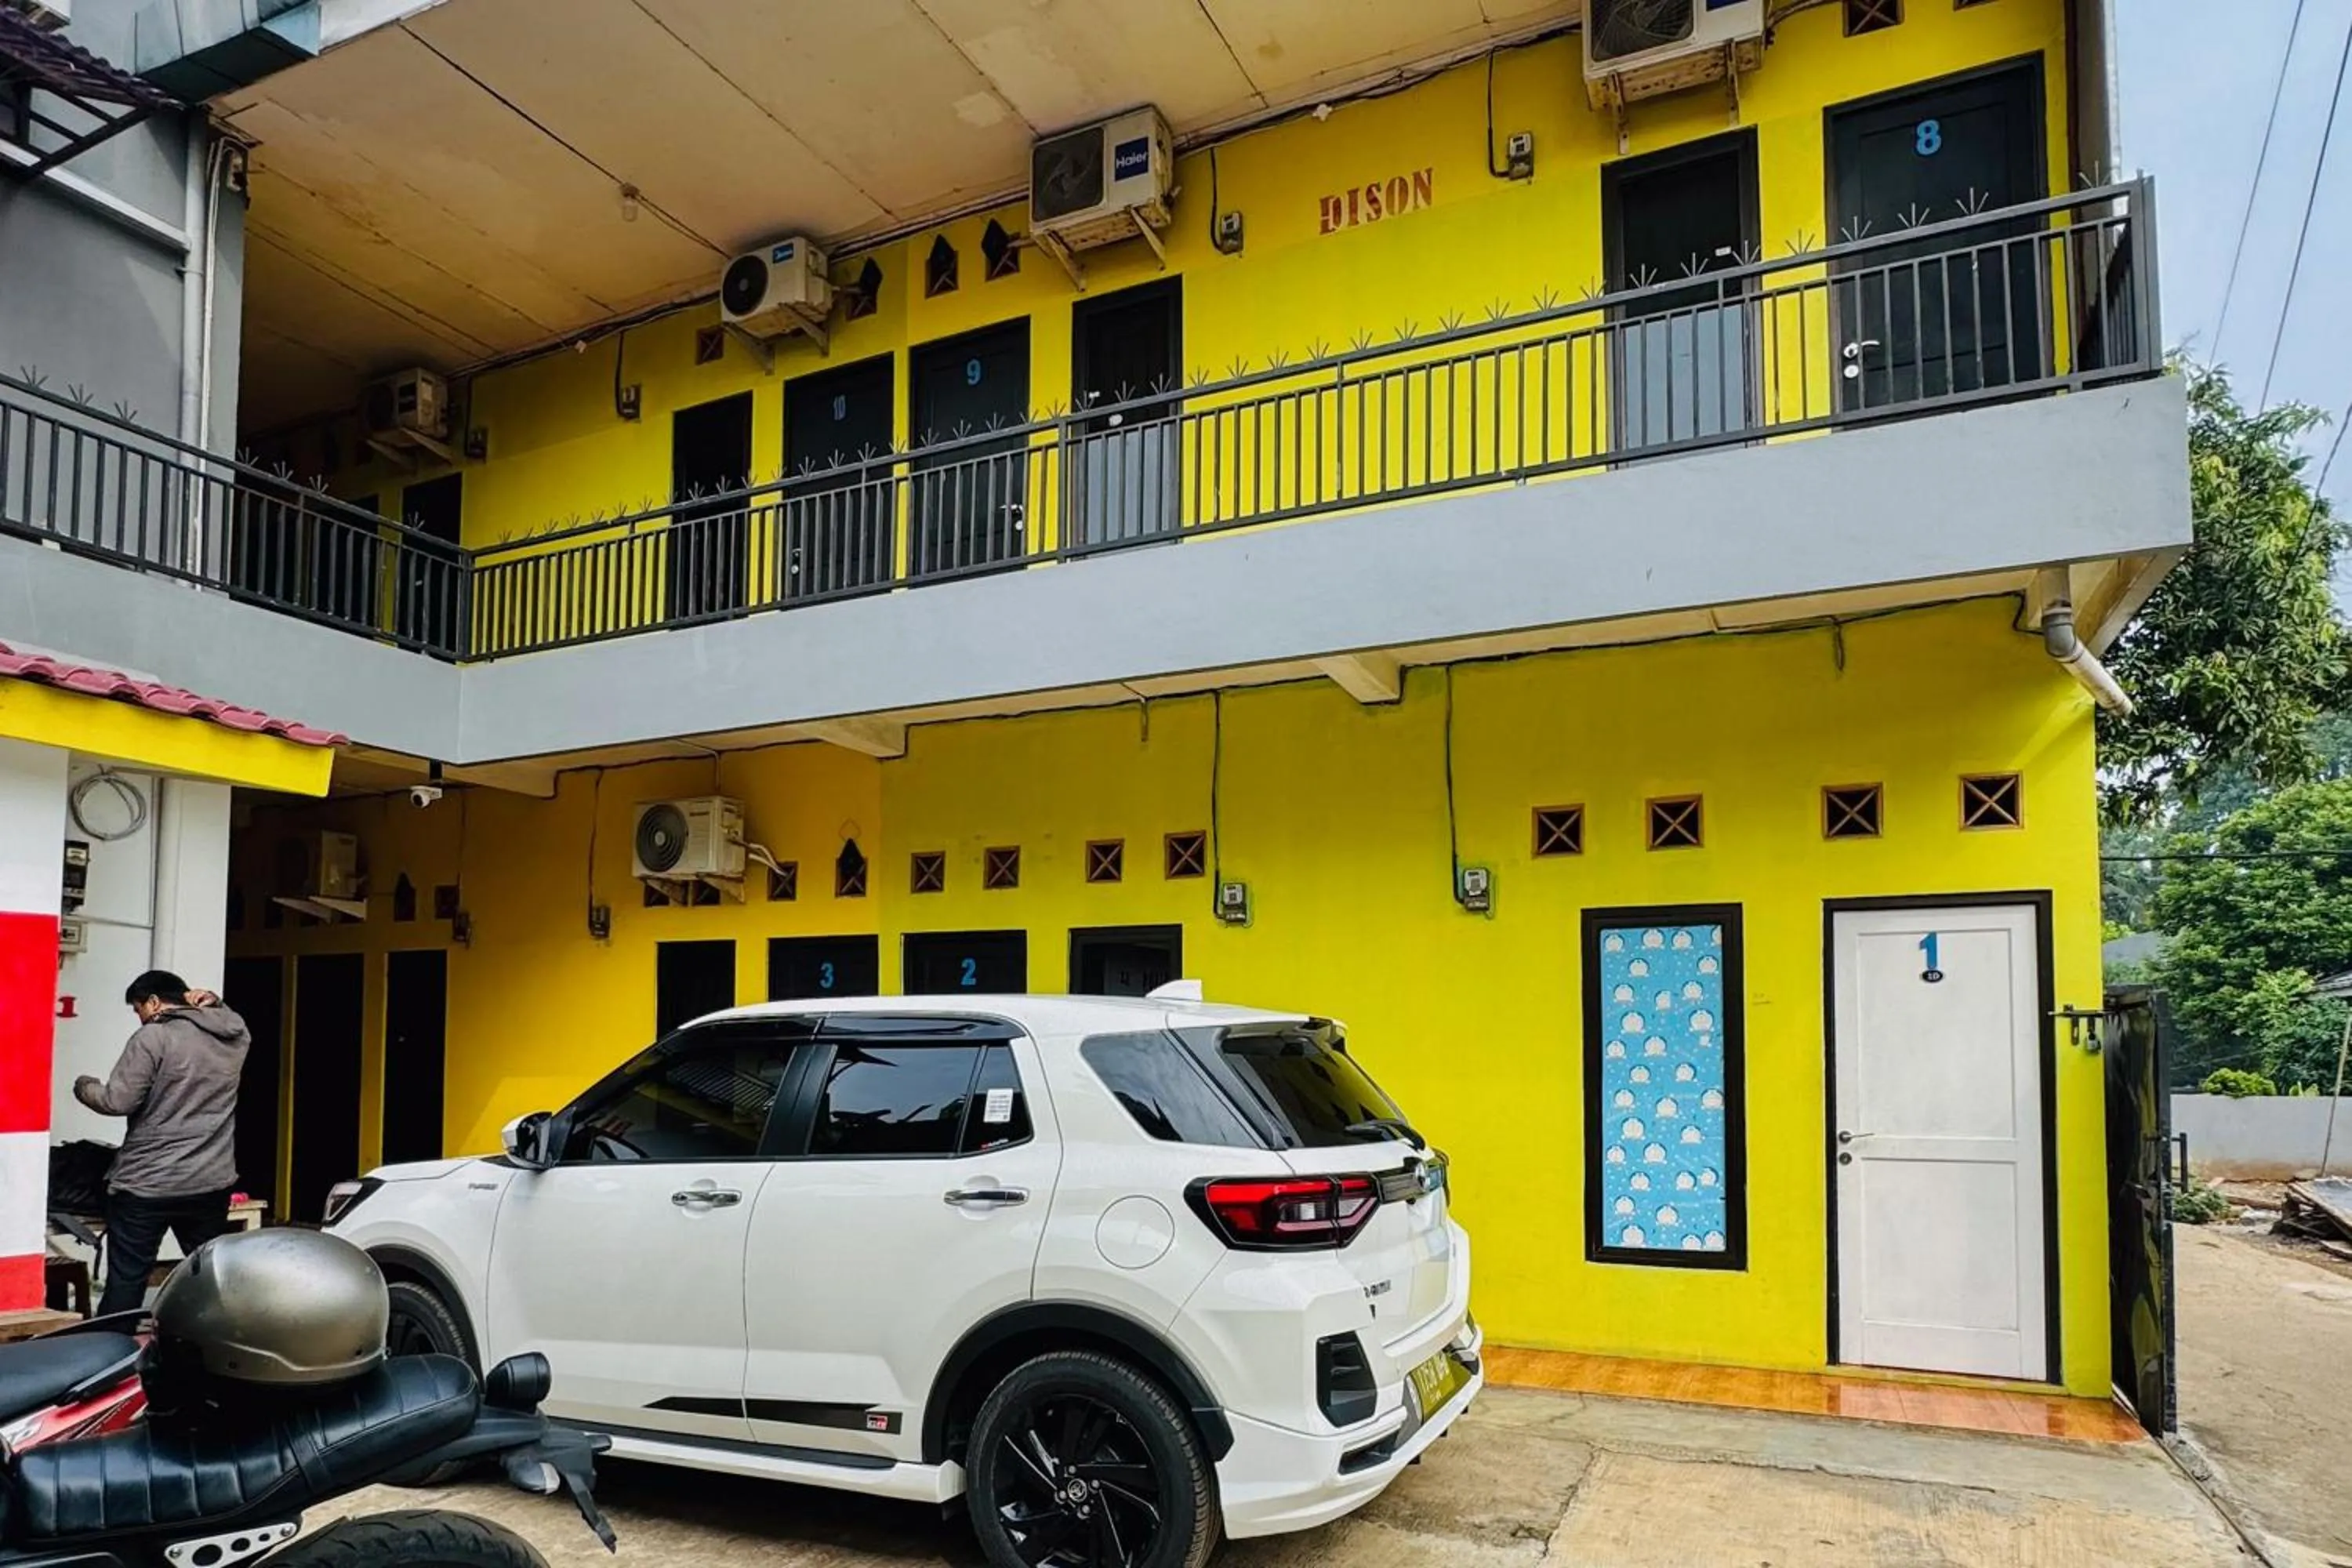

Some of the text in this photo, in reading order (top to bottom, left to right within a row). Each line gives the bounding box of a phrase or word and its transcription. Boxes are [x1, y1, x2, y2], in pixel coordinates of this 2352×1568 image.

[1916, 119, 1942, 155] 8
[1116, 151, 1147, 169] Haier
[1319, 167, 1432, 235] DISON
[967, 358, 981, 386] 9
[1918, 931, 1937, 969] 1
[820, 963, 834, 988] 3
[960, 957, 977, 985] 2
